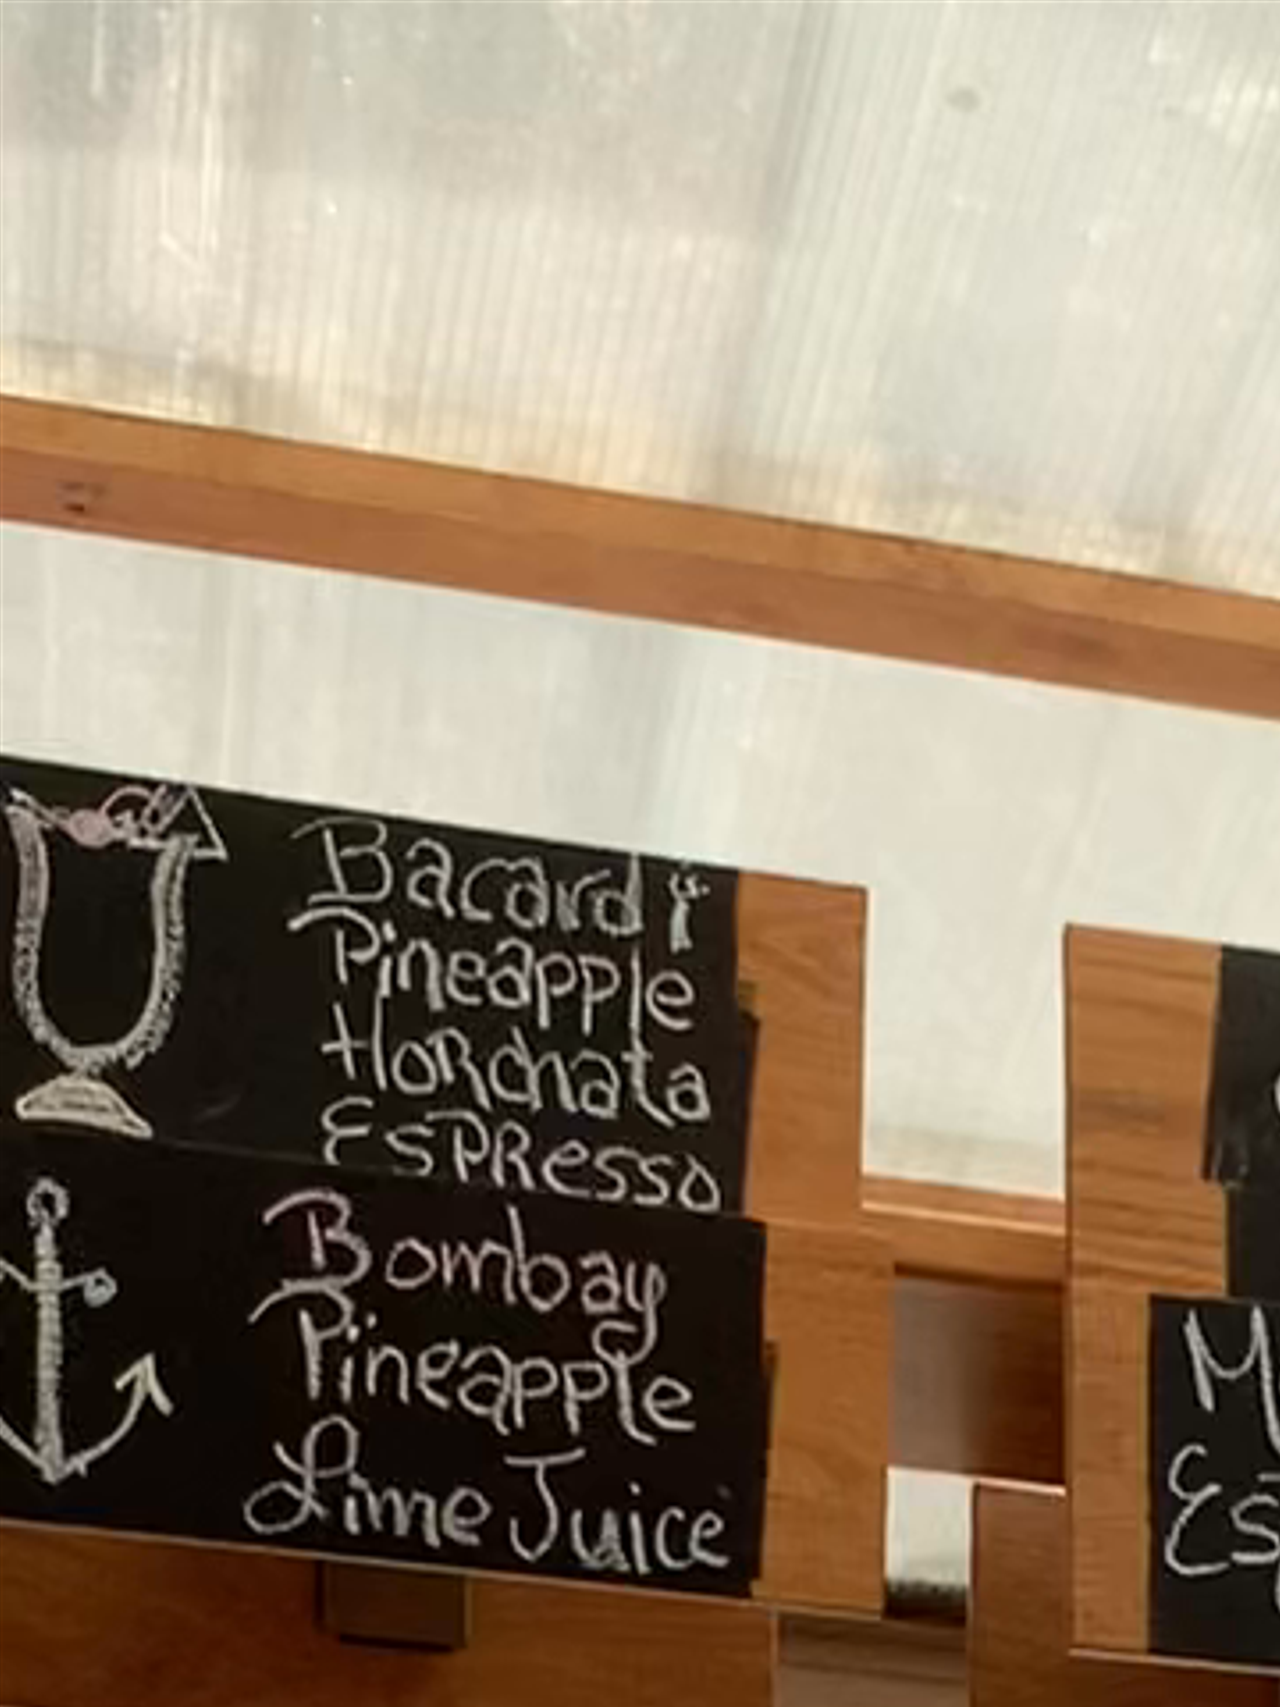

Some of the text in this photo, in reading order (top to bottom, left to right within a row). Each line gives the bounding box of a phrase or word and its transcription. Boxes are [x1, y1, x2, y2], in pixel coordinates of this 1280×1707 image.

[292, 816, 710, 952] Bacardi
[288, 906, 694, 1034] Pineapple
[263, 1189, 667, 1366] Bombay
[247, 1288, 697, 1445] Pineapple
[243, 1414, 730, 1575] Lime Juice
